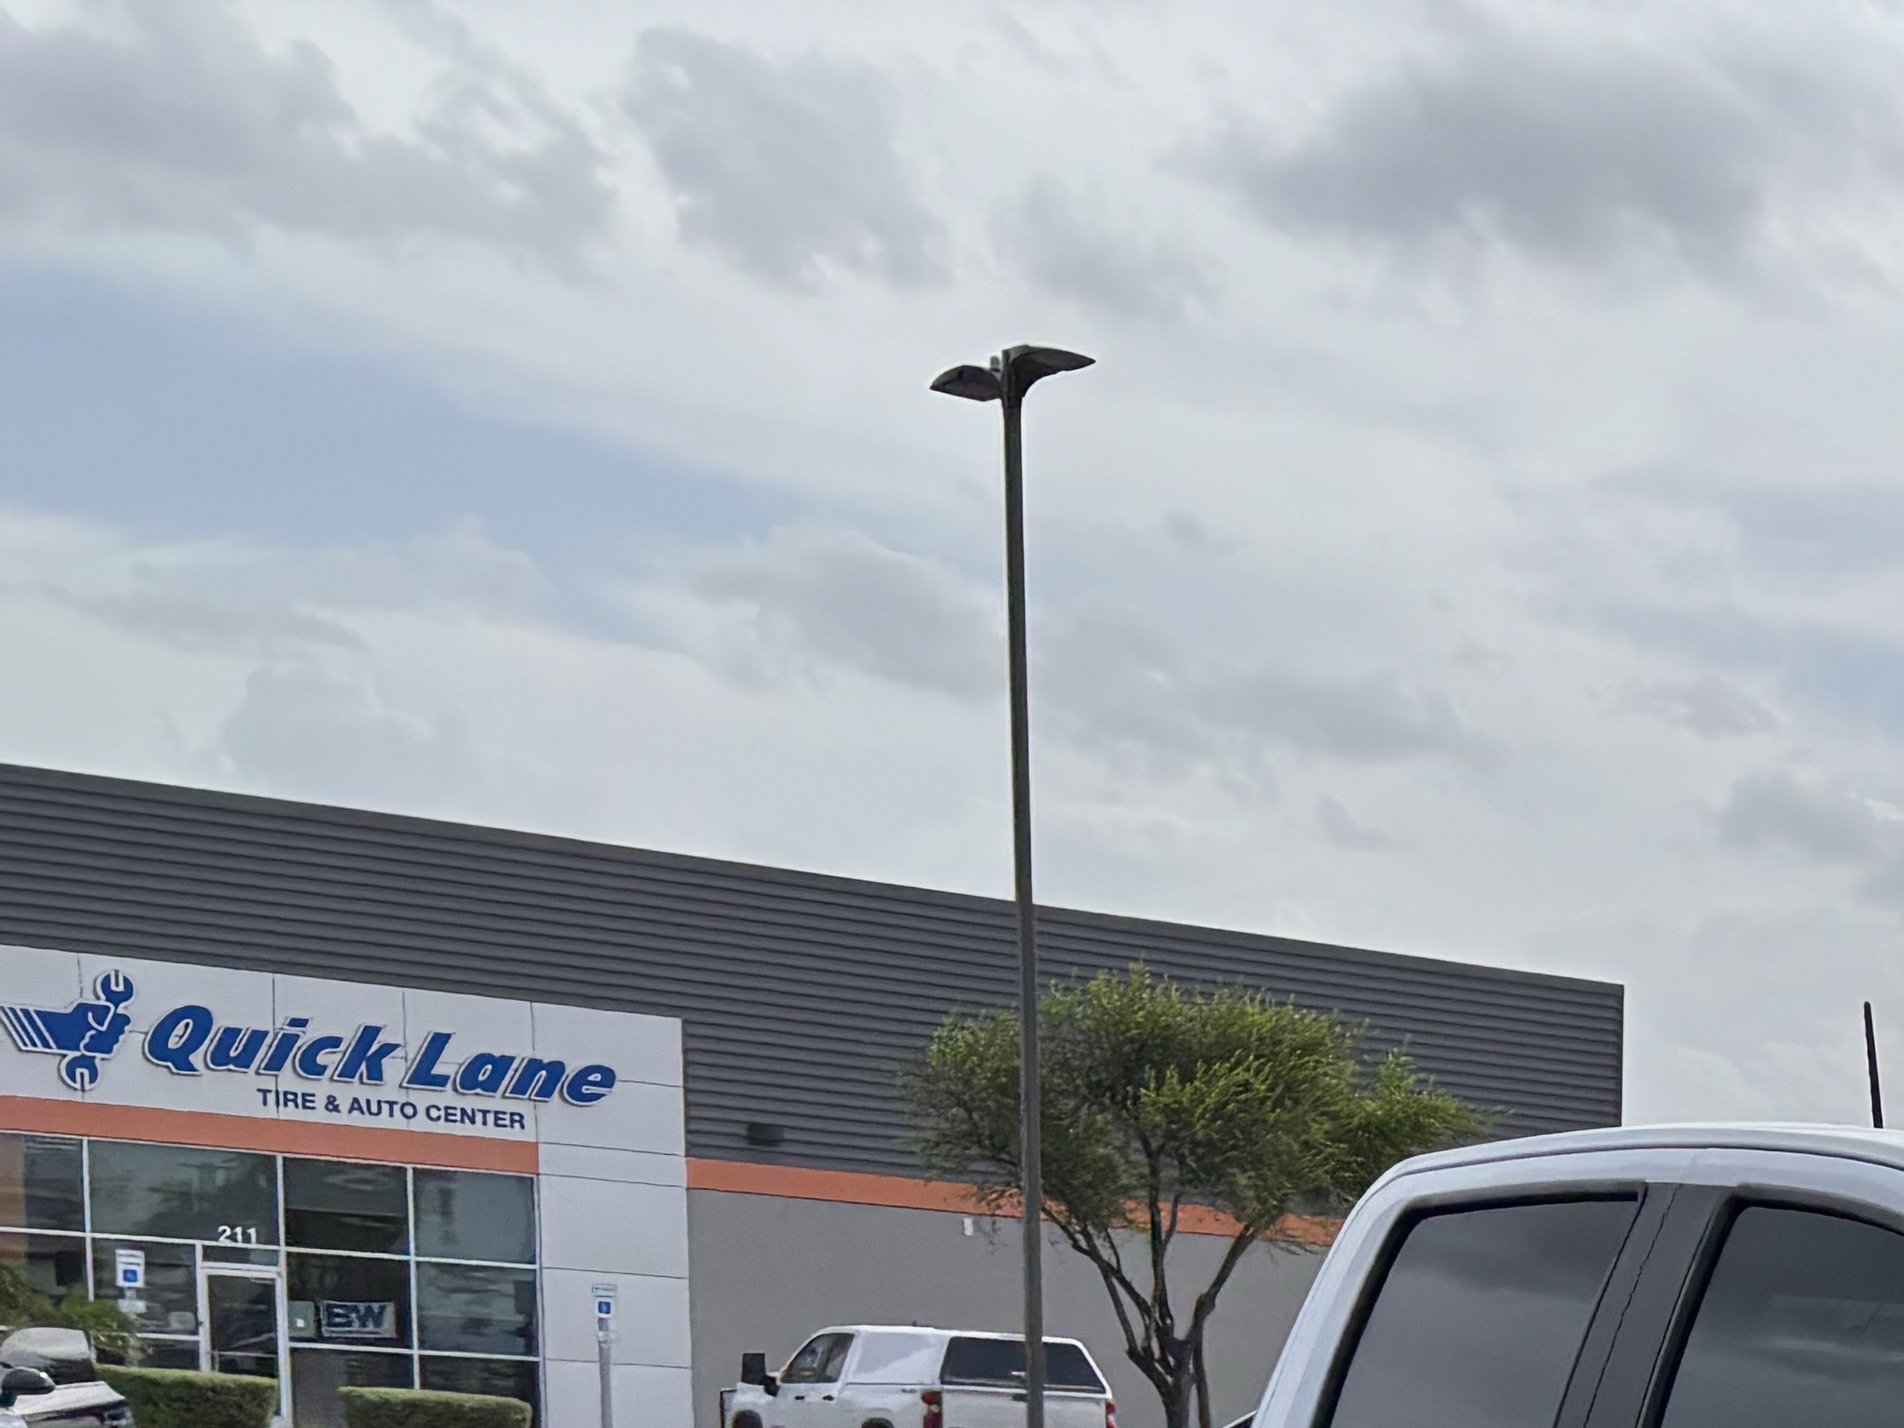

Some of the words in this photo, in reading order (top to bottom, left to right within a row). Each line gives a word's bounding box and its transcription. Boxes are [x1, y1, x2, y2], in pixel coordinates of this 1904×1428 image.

[145, 1003, 404, 1084] Quick
[401, 1031, 617, 1106] Lane
[256, 1088, 317, 1110] TIRE
[324, 1094, 342, 1114] &
[347, 1097, 418, 1120] AUTO
[425, 1104, 526, 1131] CENTER
[217, 1225, 257, 1244] 211
